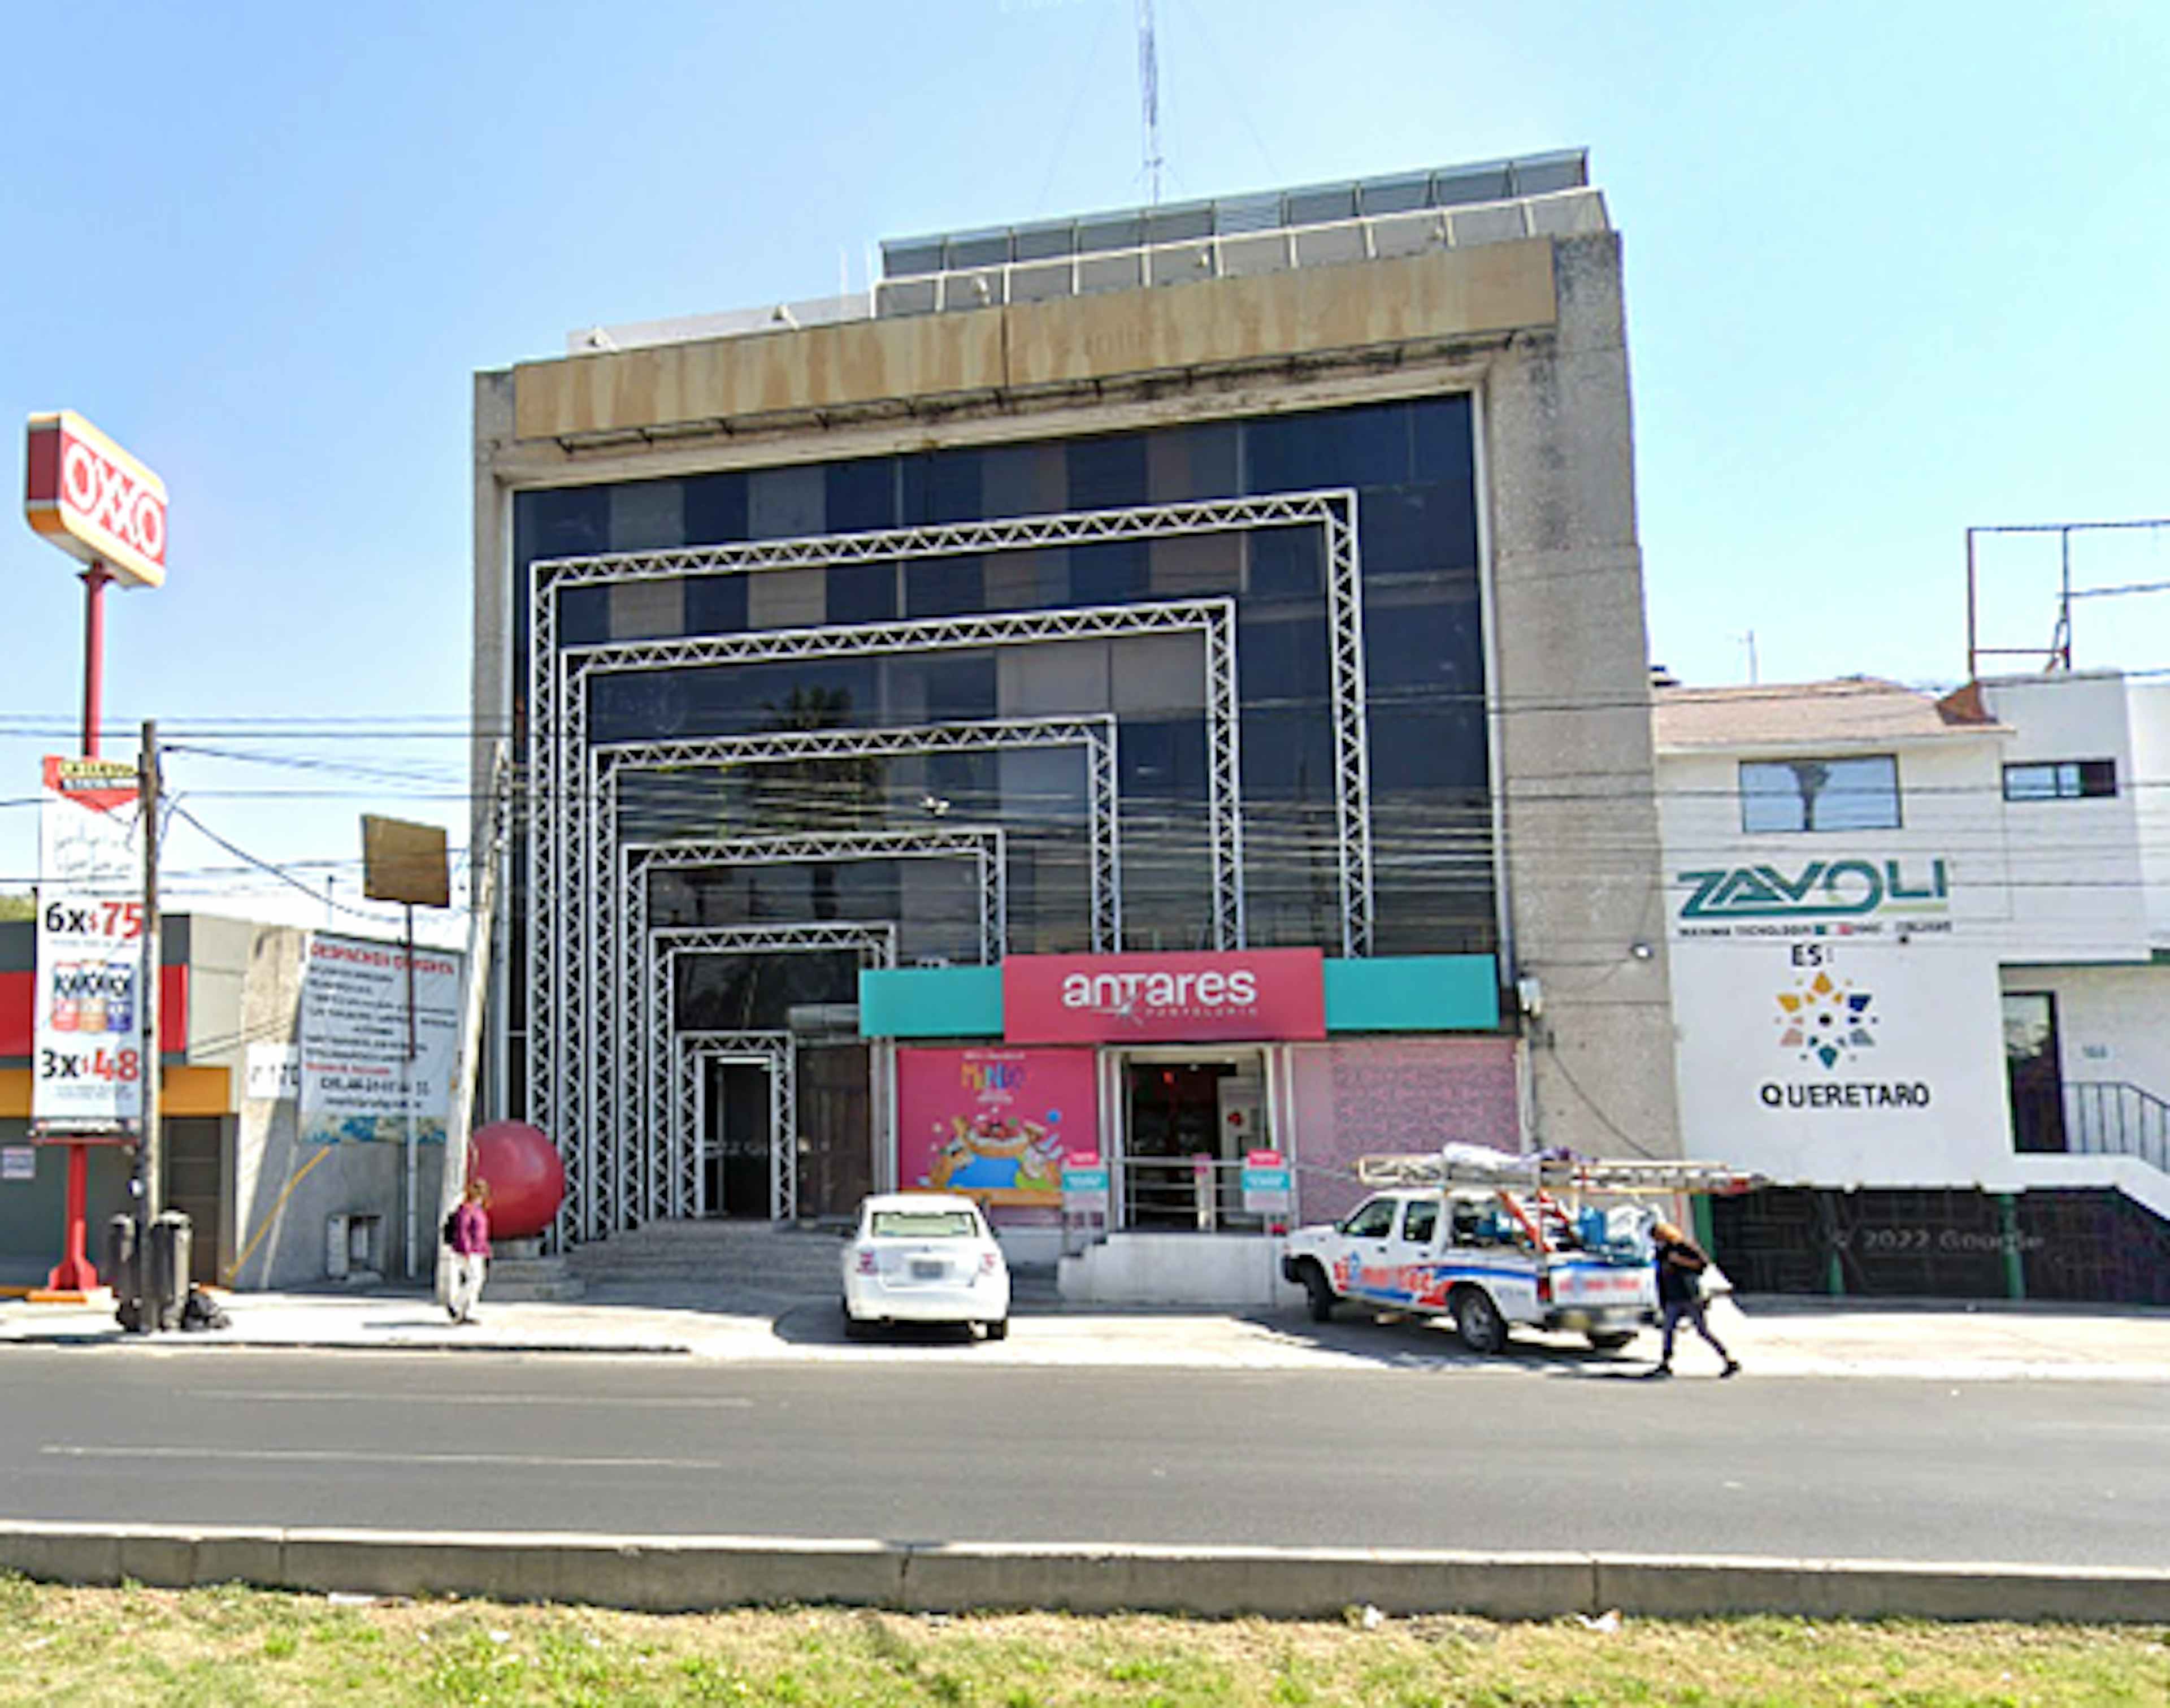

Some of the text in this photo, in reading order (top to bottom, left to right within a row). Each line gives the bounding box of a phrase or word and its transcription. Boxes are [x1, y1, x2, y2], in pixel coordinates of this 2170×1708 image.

[64, 441, 163, 558] OXXO
[1678, 860, 1948, 918] ZAVOLI
[1062, 970, 1257, 1008] antares
[1761, 1083, 1930, 1108] QUERETARO
